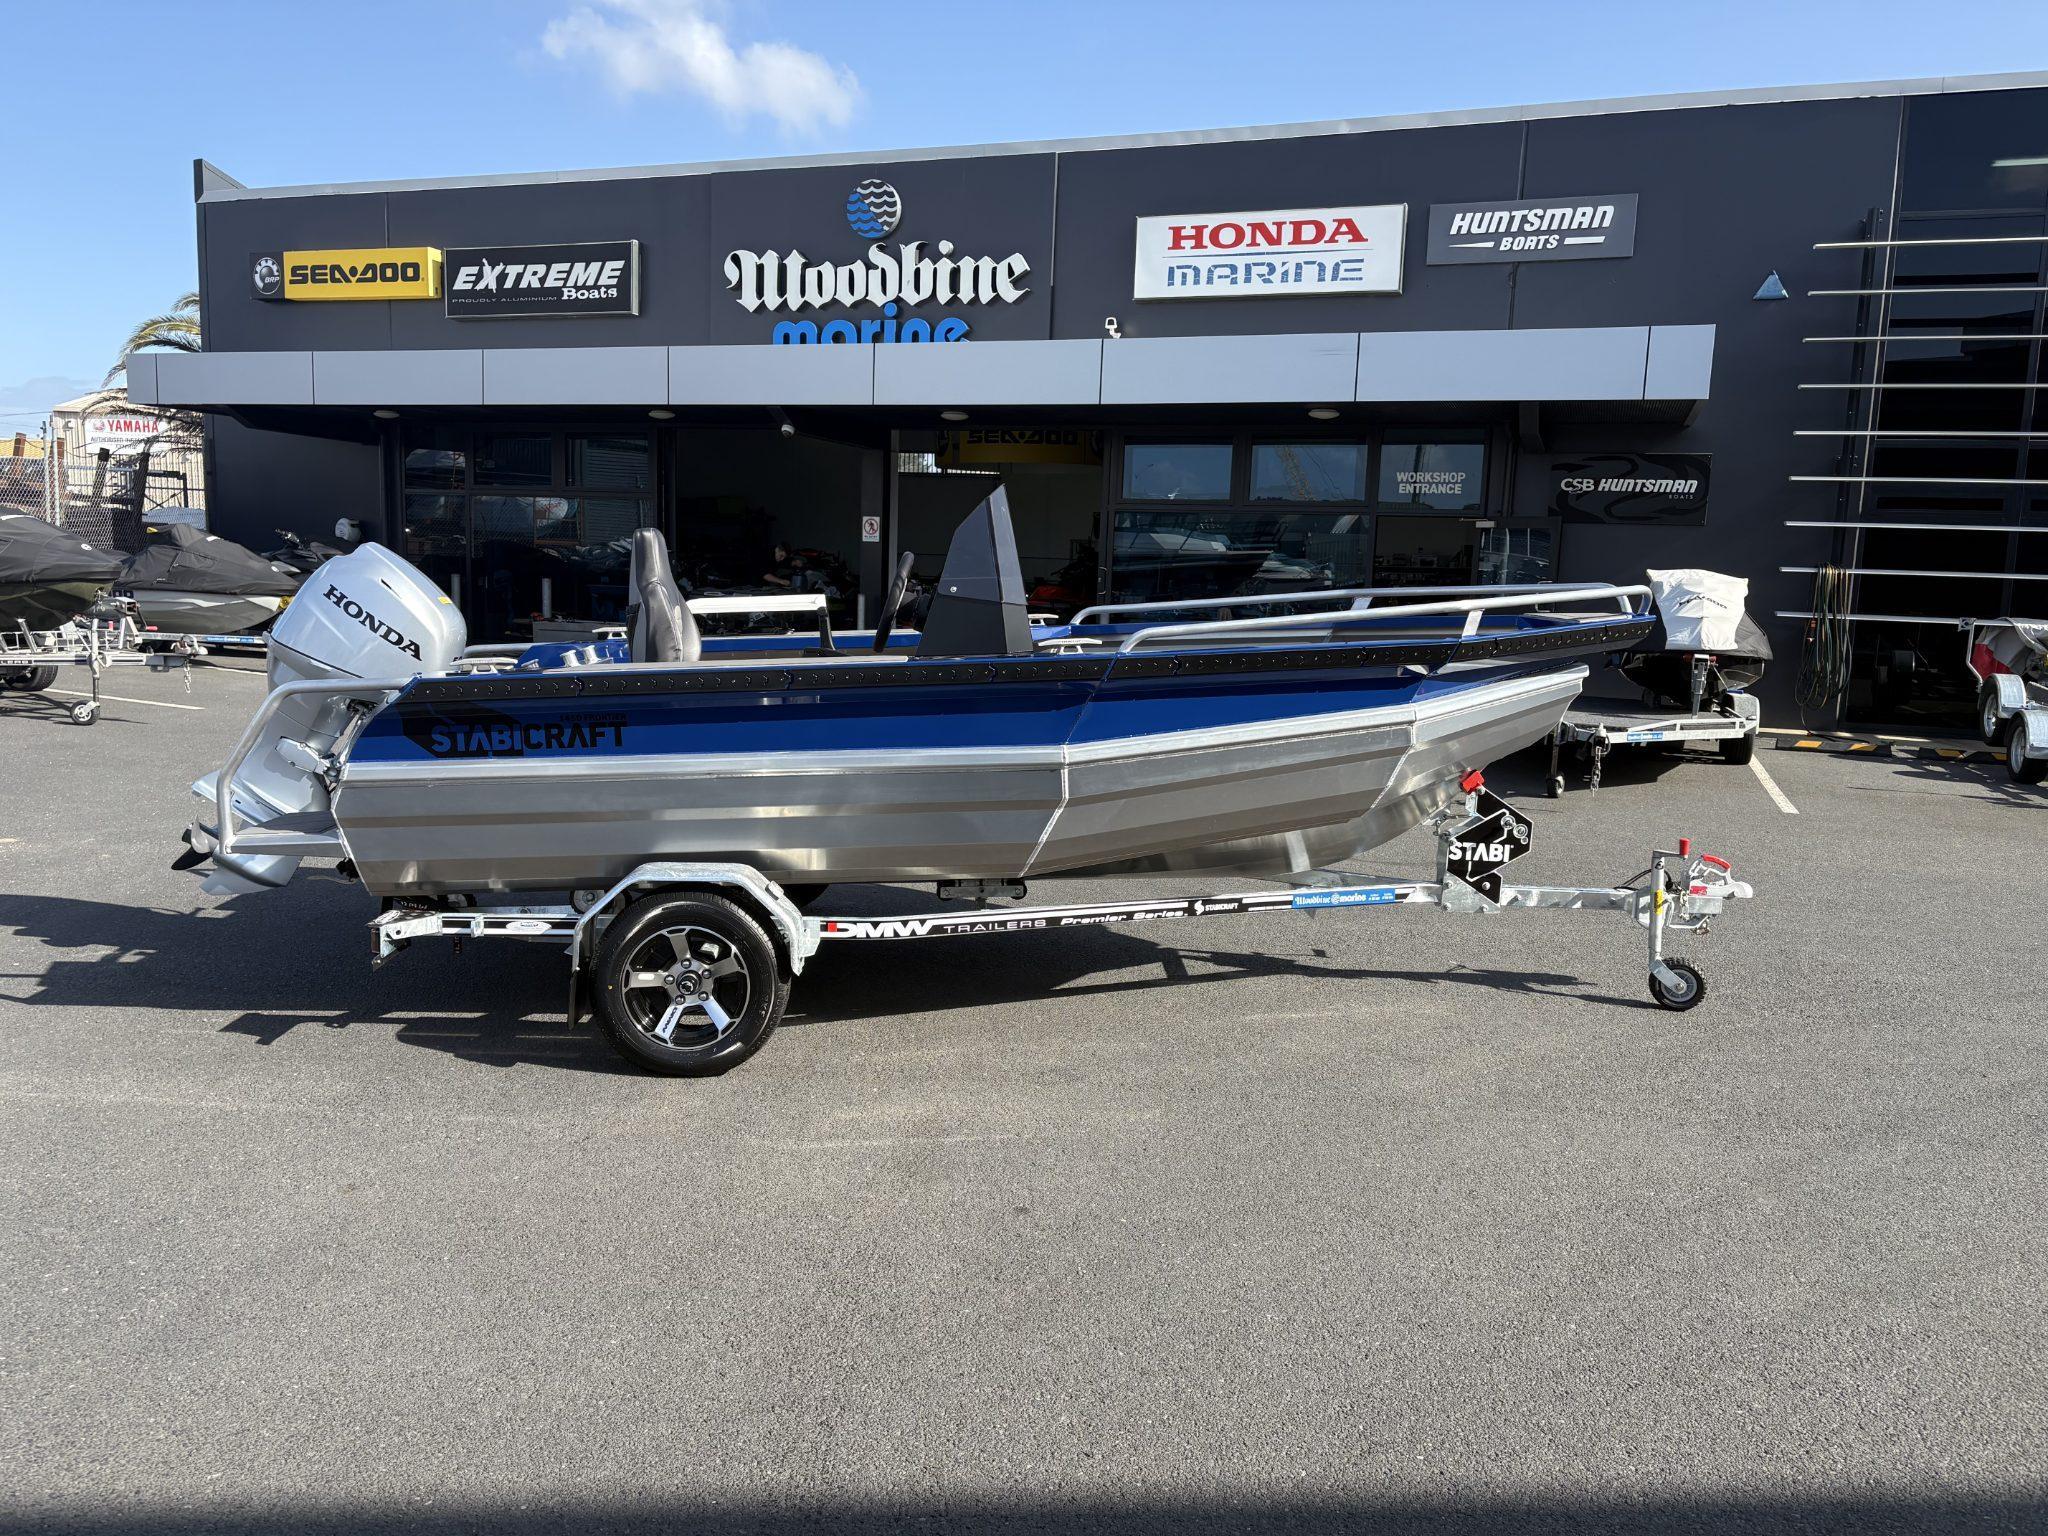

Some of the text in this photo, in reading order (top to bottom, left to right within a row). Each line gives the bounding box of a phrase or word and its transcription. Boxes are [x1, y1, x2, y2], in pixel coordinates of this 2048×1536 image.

[1450, 205, 1615, 235] HUNTSMAN
[1167, 218, 1369, 250] HONDA
[1500, 235, 1560, 250] BOATS
[452, 258, 626, 293] EXTREME
[723, 240, 1031, 313] Woodbine
[1167, 258, 1364, 286] MARINE
[561, 287, 618, 300] Boats
[772, 302, 969, 345] marine
[107, 419, 159, 433] YAMAHA
[1396, 471, 1466, 482] WORKSHOP
[1398, 483, 1462, 494] ENTRANCE
[1560, 478, 1698, 493] CSB HUNTSMAN
[322, 584, 422, 661] HONDA
[431, 721, 627, 752] STABICRAFT
[1448, 841, 1511, 863] STABI
[820, 919, 932, 938] DMW
[943, 919, 1047, 934] TRAILERS
[1060, 913, 1127, 926] Premier
